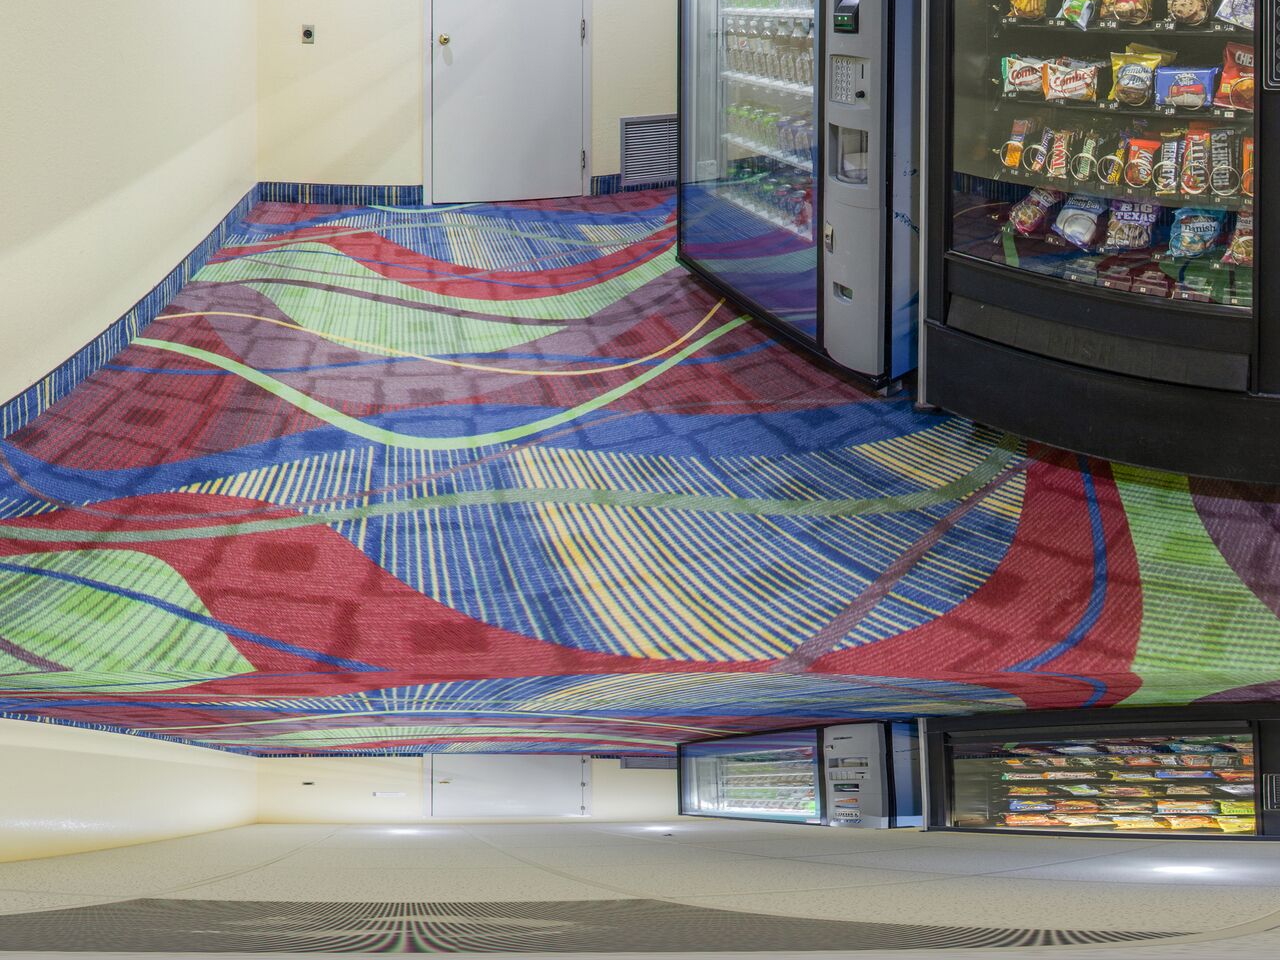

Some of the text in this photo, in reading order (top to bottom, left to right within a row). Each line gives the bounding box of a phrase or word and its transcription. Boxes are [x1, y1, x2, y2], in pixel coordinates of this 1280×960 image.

[1067, 197, 1087, 208] Honey
[1121, 203, 1152, 212] BIG
[1115, 212, 1156, 222] TEXAS
[1184, 223, 1216, 233] Danish
